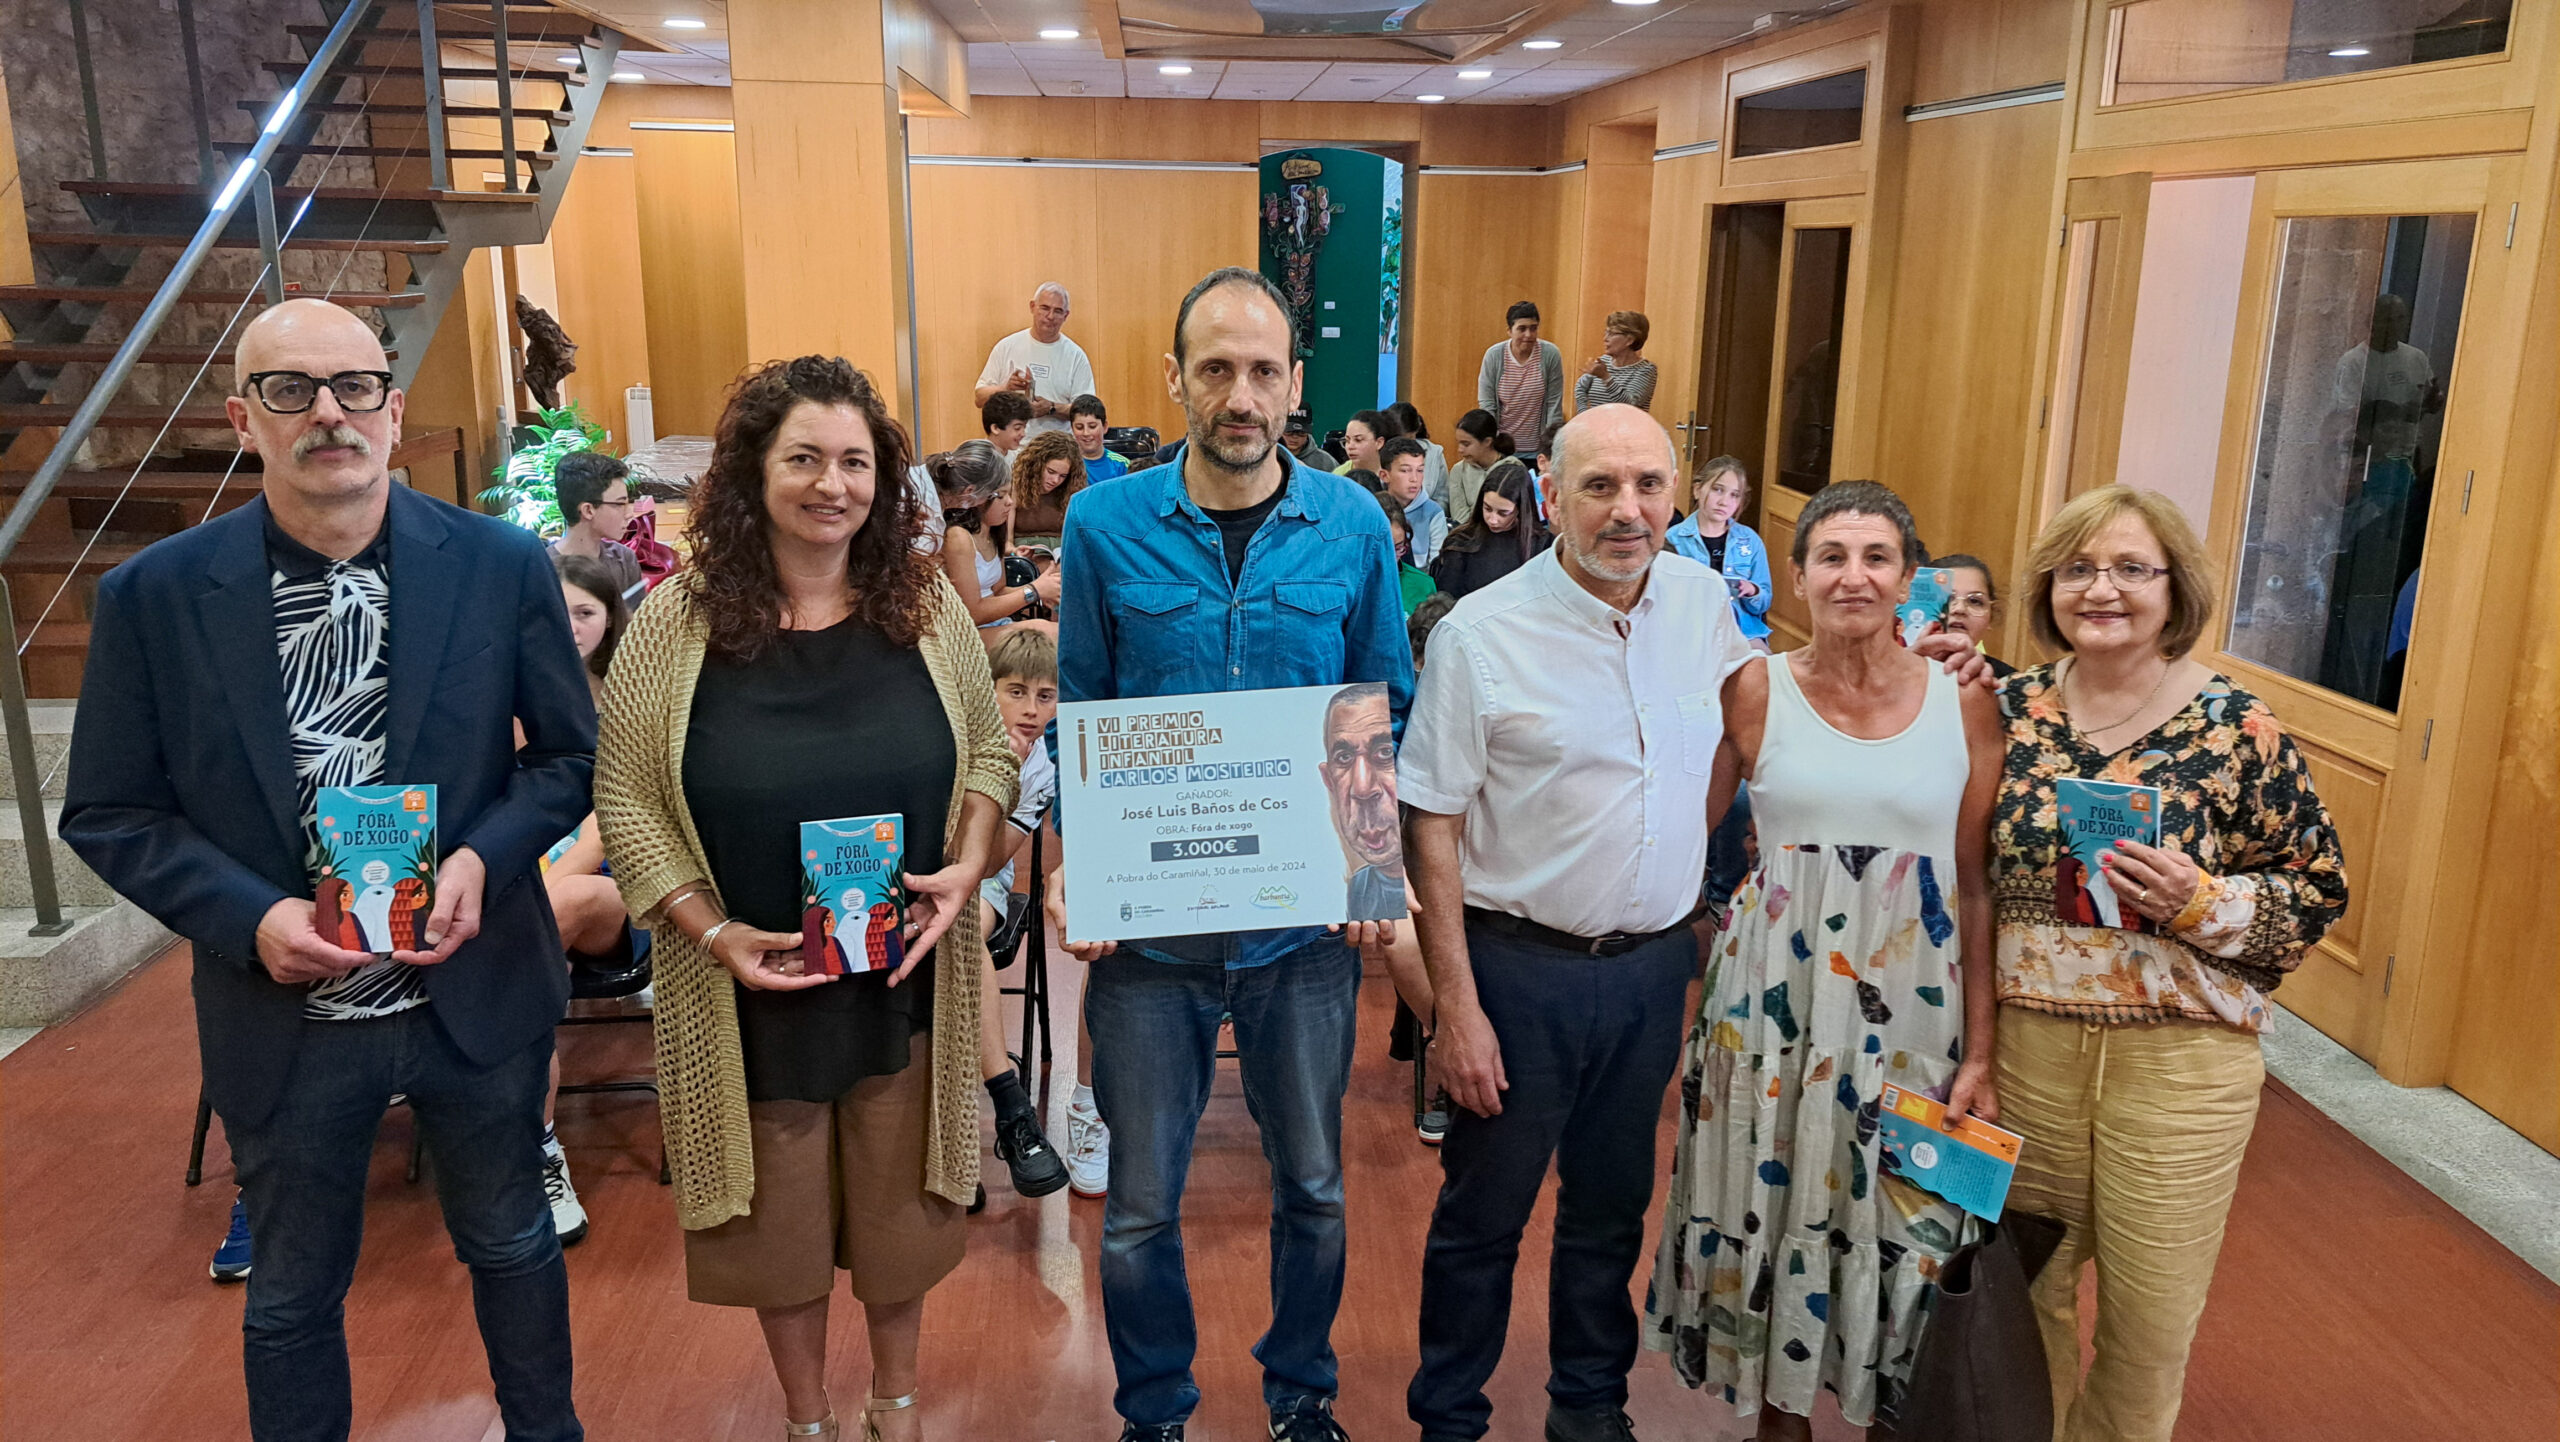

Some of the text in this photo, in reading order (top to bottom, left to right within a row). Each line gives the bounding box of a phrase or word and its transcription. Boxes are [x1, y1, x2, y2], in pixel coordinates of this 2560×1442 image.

[1098, 711, 1204, 733] VI PREMIO
[1099, 728, 1222, 751] LITERATURA
[1100, 748, 1194, 770] INFANTIL
[1101, 759, 1291, 788] CARLOS MOSTEIRO
[1176, 789, 1232, 801] GAÑADOR:
[1121, 797, 1289, 820] José Luis Baños de Cos
[2089, 804, 2124, 822] FÓRA
[357, 810, 396, 829] FÓRA
[1156, 822, 1253, 835] OBRA: Fóra de xogo
[2078, 819, 2136, 838] DE XOGO
[343, 829, 409, 846] DE XOGO
[836, 841, 870, 860] FÓRA
[1172, 839, 1238, 857] 3.000€
[824, 858, 881, 877] DE XOGO
[1106, 861, 1306, 883] A Pobra do Caramiñal, 30 de maio de 2024
